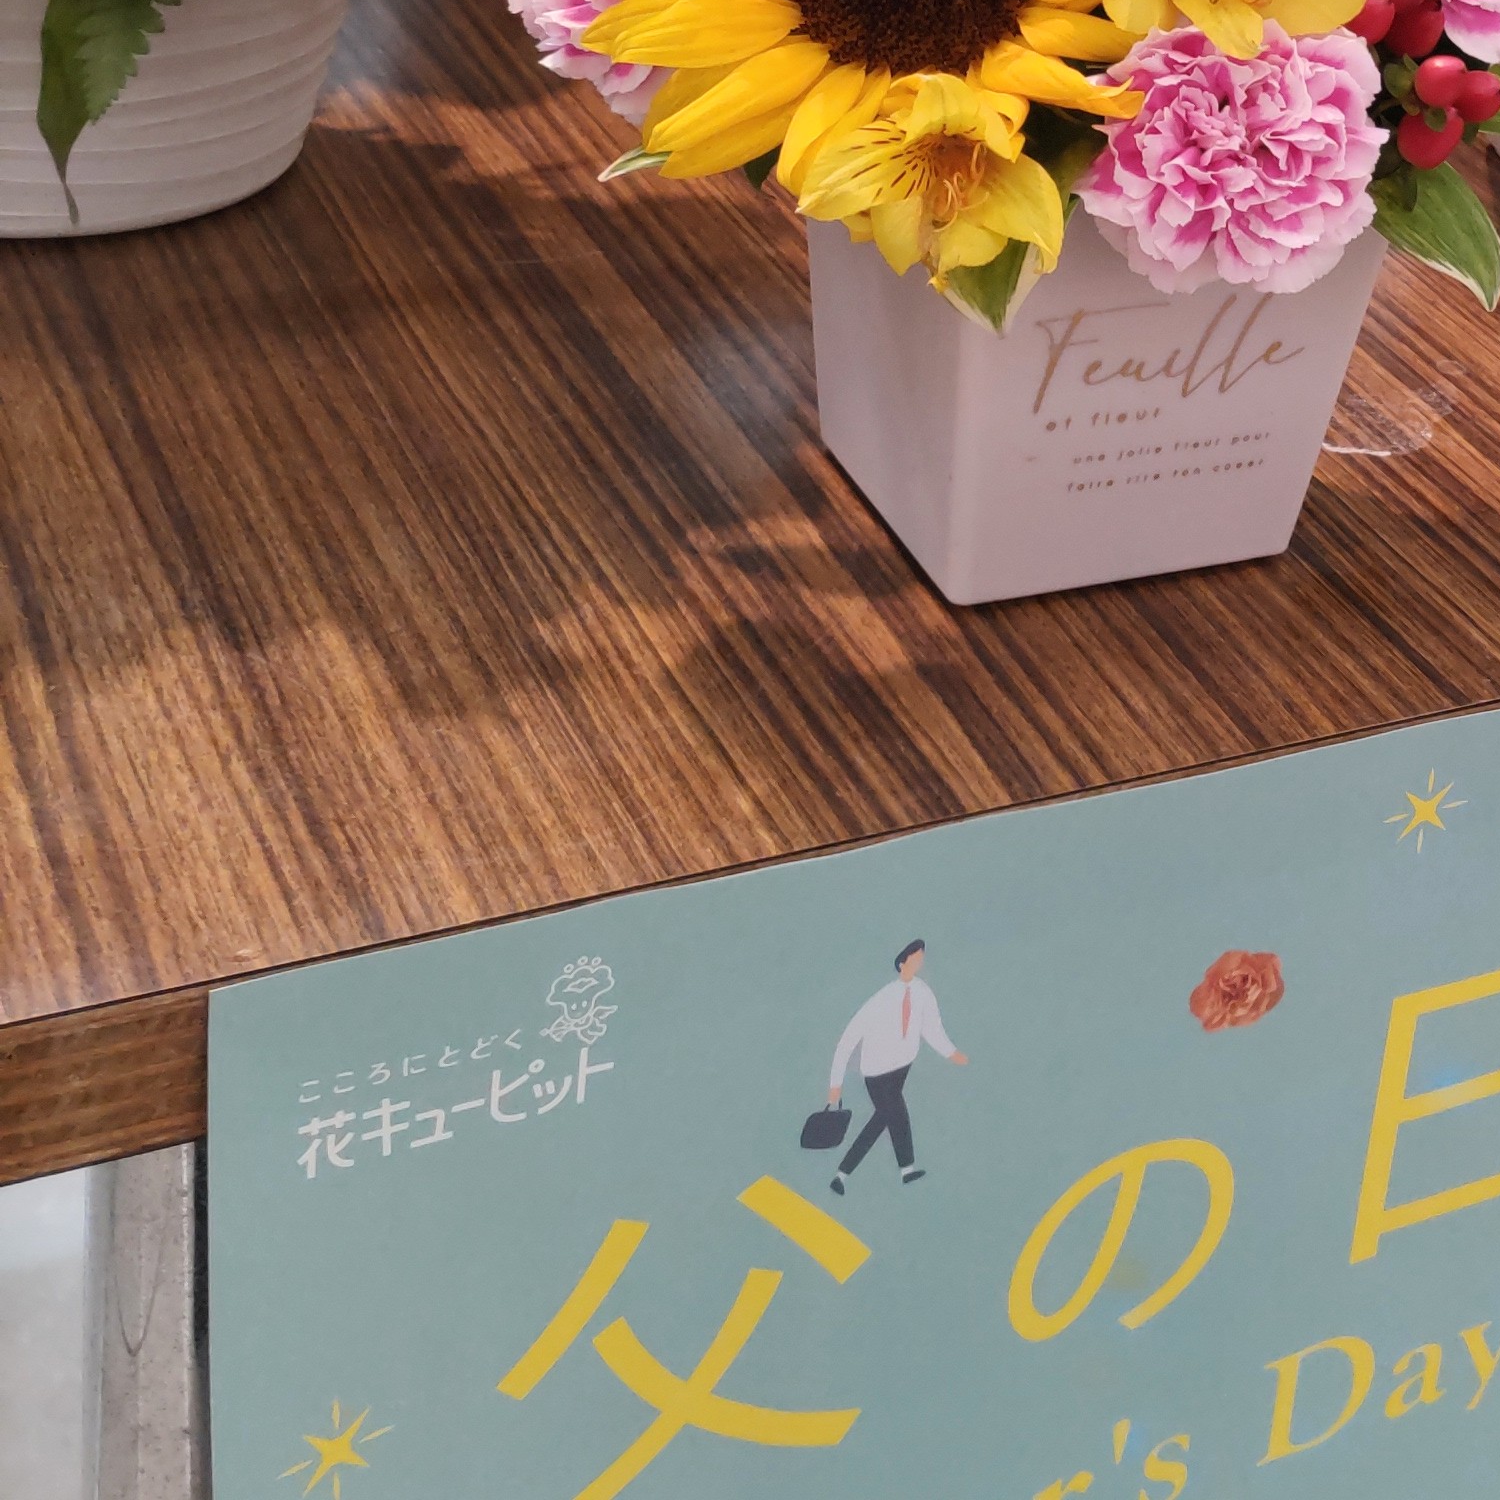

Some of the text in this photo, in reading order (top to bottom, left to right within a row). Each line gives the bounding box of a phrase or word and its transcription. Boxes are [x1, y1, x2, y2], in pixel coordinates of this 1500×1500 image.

[1034, 291, 1306, 415] Feuille
[296, 1046, 616, 1181] 花キューピット
[297, 1028, 523, 1105] こころにとどく
